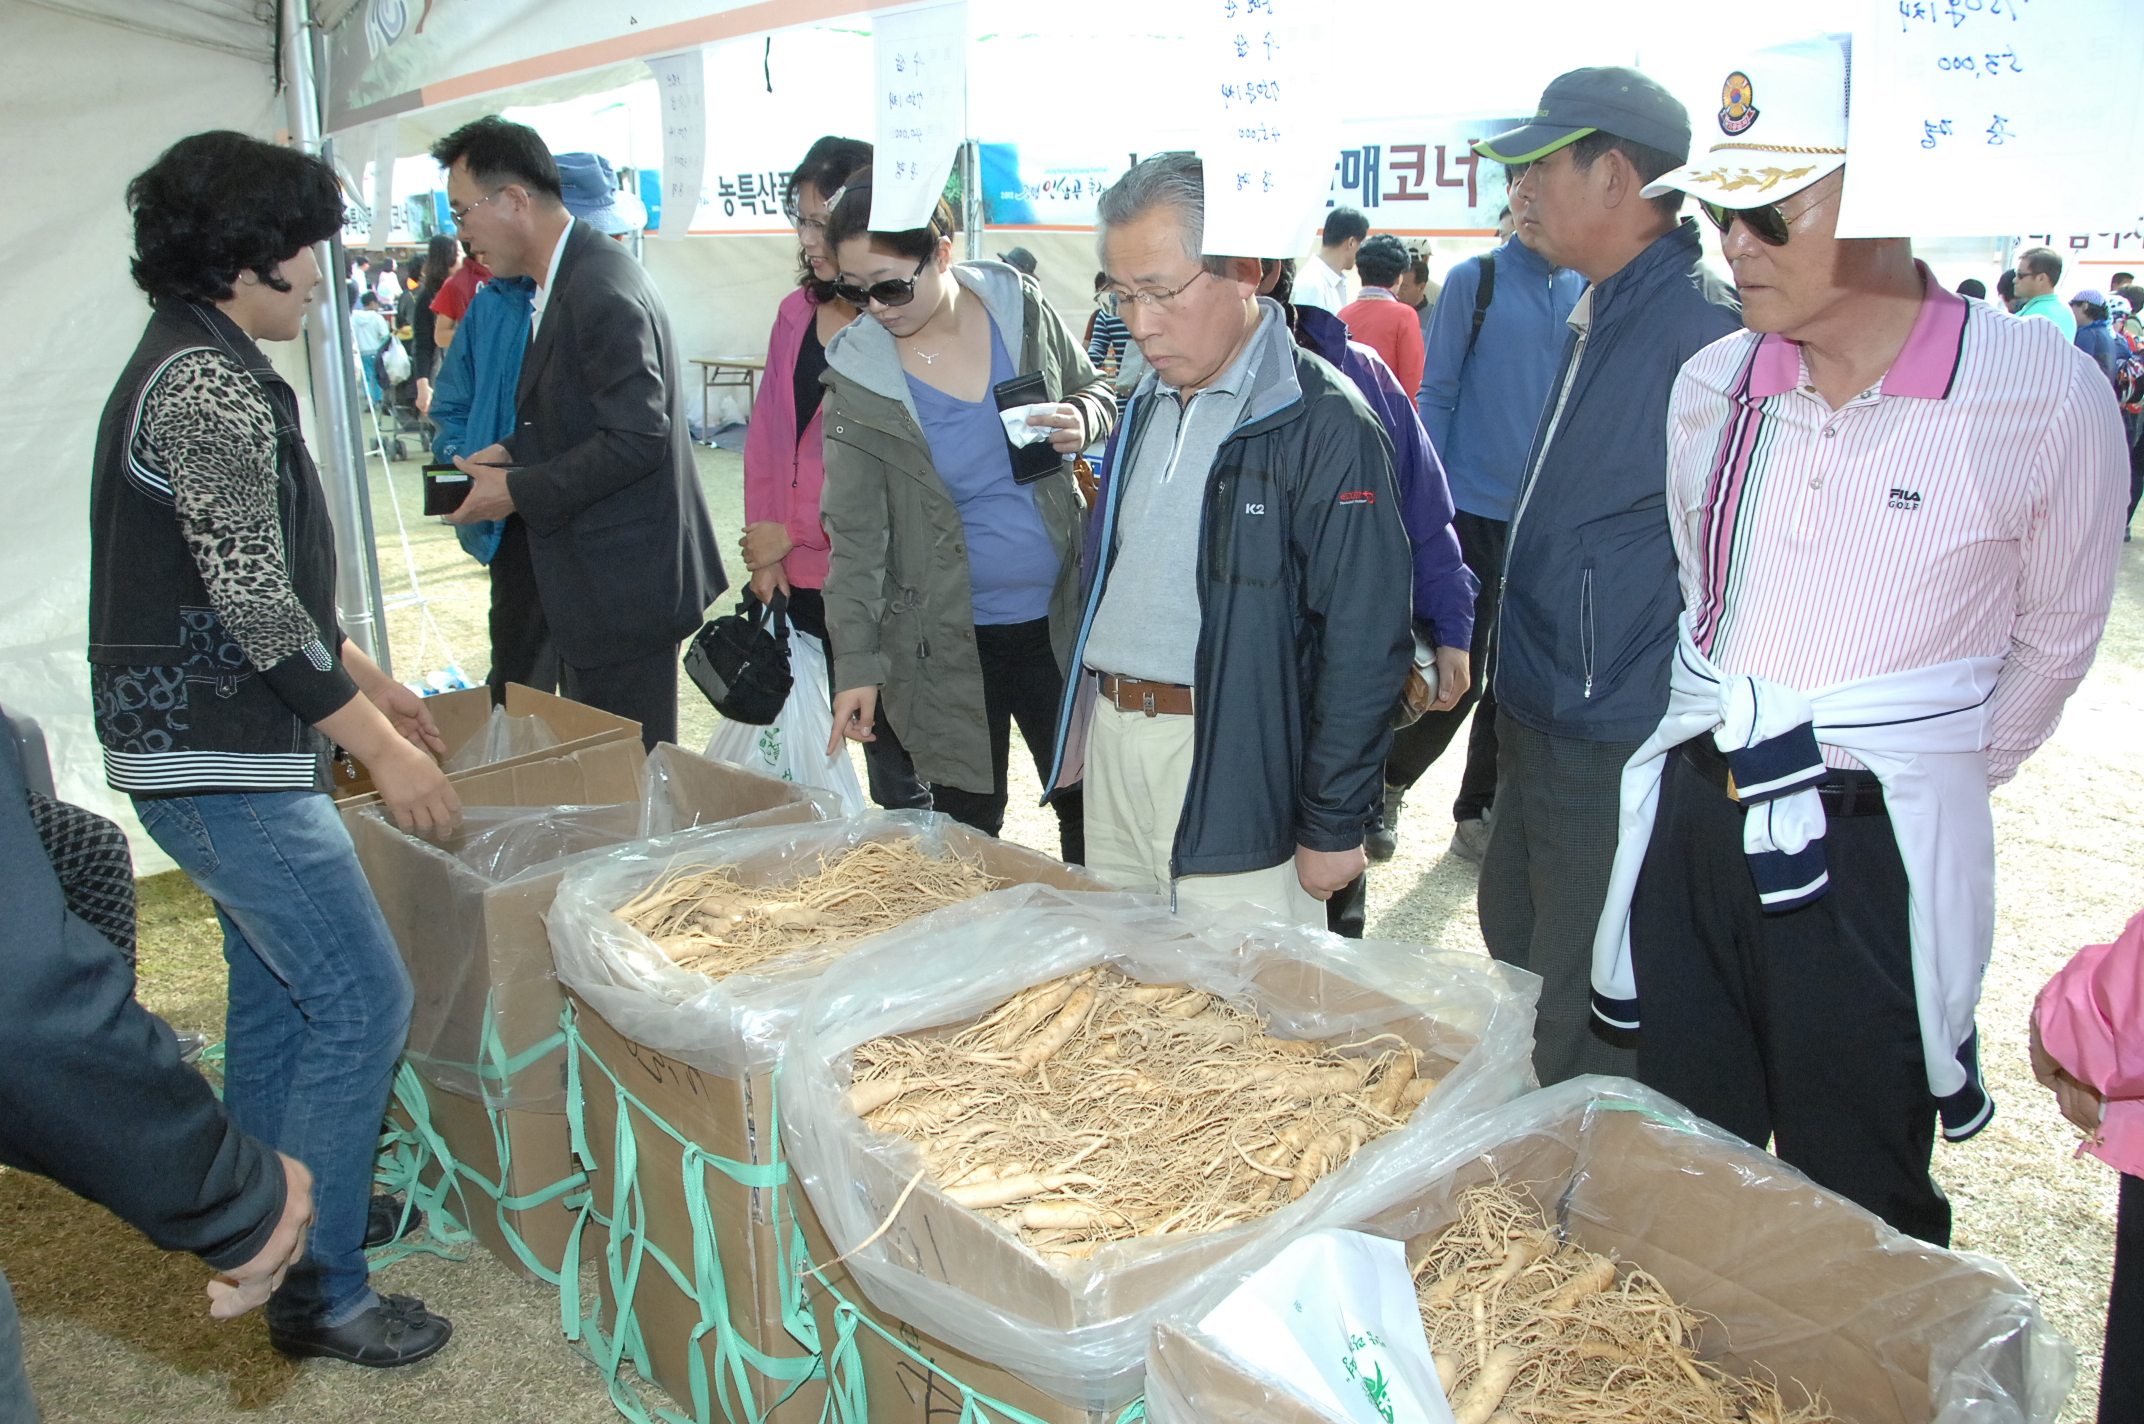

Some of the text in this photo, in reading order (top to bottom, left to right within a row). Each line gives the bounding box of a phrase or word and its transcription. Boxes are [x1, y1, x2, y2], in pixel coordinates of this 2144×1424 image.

[1326, 138, 1481, 209] 매코너
[1890, 488, 1921, 502] FILA
[1245, 503, 1265, 515] K2
[1888, 500, 1919, 511] GOLF
